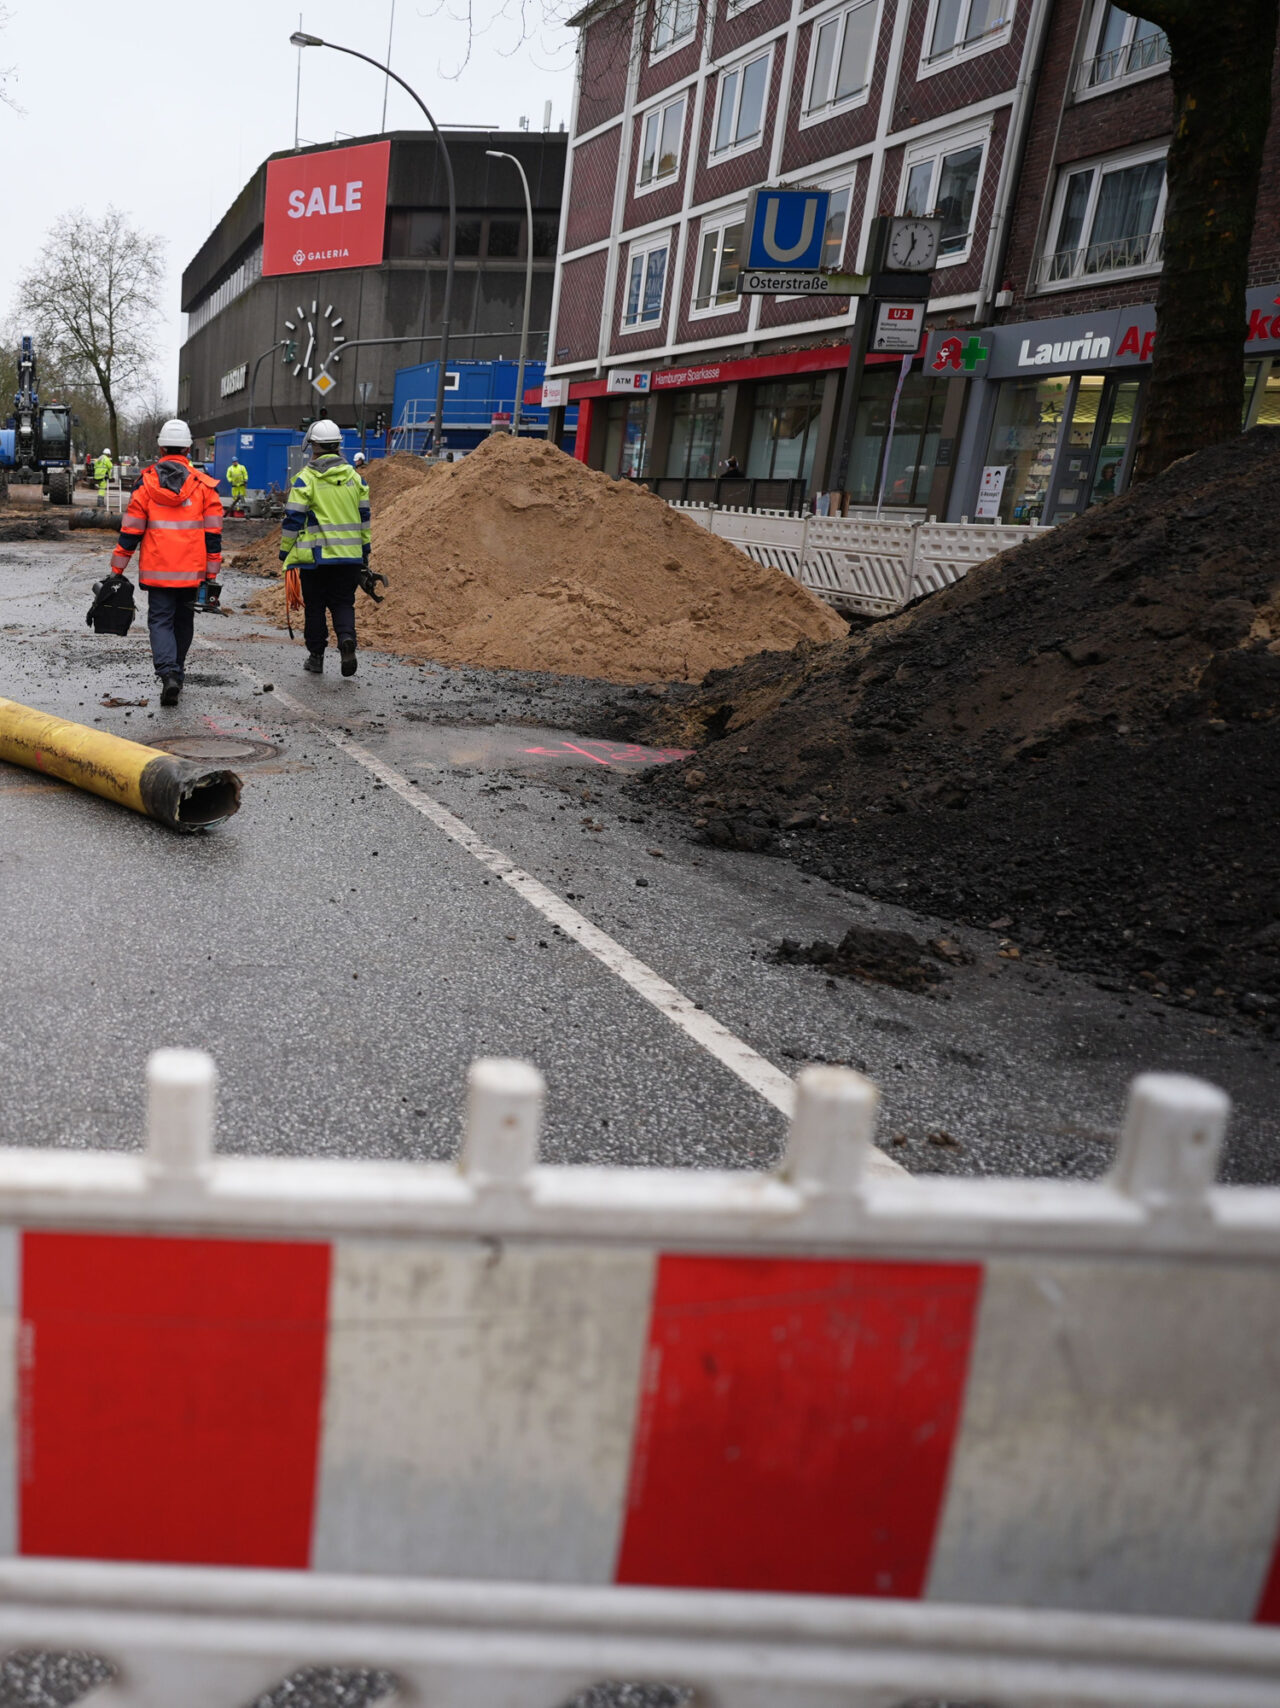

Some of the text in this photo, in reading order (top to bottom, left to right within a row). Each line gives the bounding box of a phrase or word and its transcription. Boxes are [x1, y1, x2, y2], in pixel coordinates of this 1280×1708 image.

[287, 180, 363, 219] SALE
[763, 198, 819, 262] U
[308, 248, 349, 261] GALERIA
[749, 276, 828, 290] Osterstraße
[894, 310, 908, 319] U 2
[1017, 331, 1111, 367] Laurin
[615, 377, 631, 385] ATM
[655, 367, 720, 385] Hamburger Sparkasse
